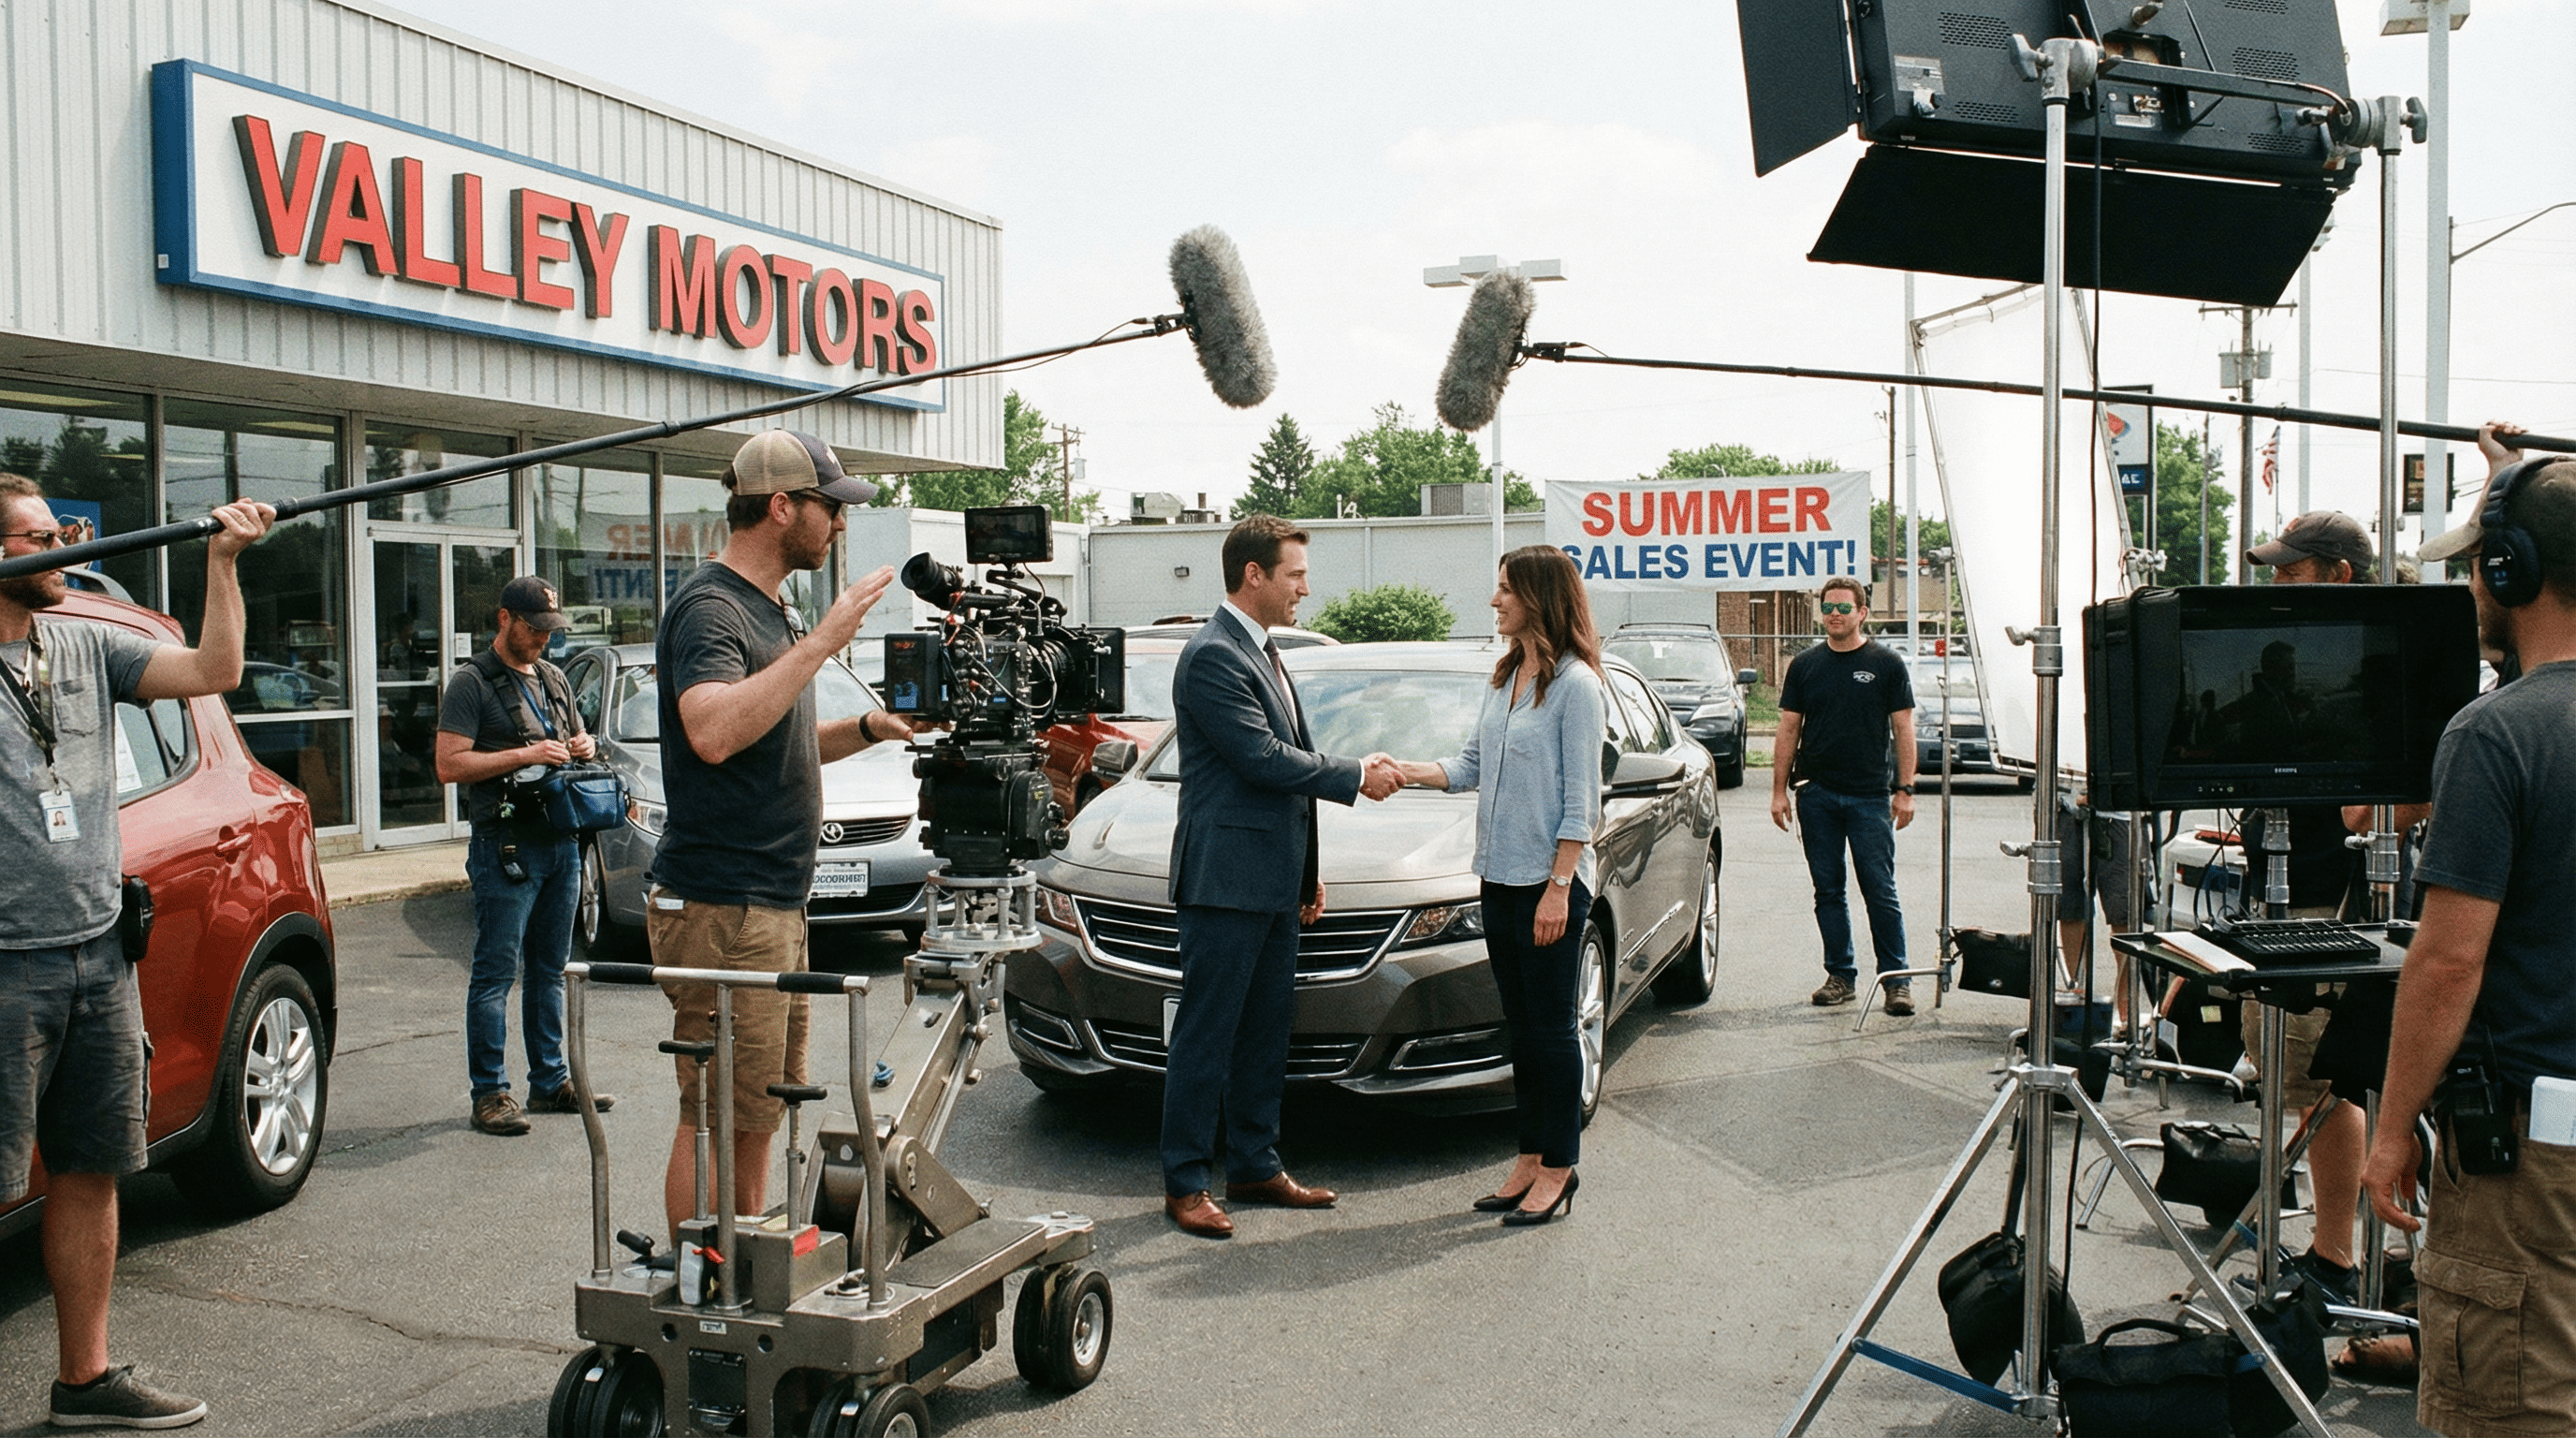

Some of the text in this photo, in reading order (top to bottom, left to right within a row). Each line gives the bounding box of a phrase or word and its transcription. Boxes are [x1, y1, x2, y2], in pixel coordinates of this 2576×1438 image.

[233, 114, 937, 377] VALLEY MOTORS
[1581, 486, 1832, 536] SUMMER
[1705, 539, 1856, 578] EVENT!
